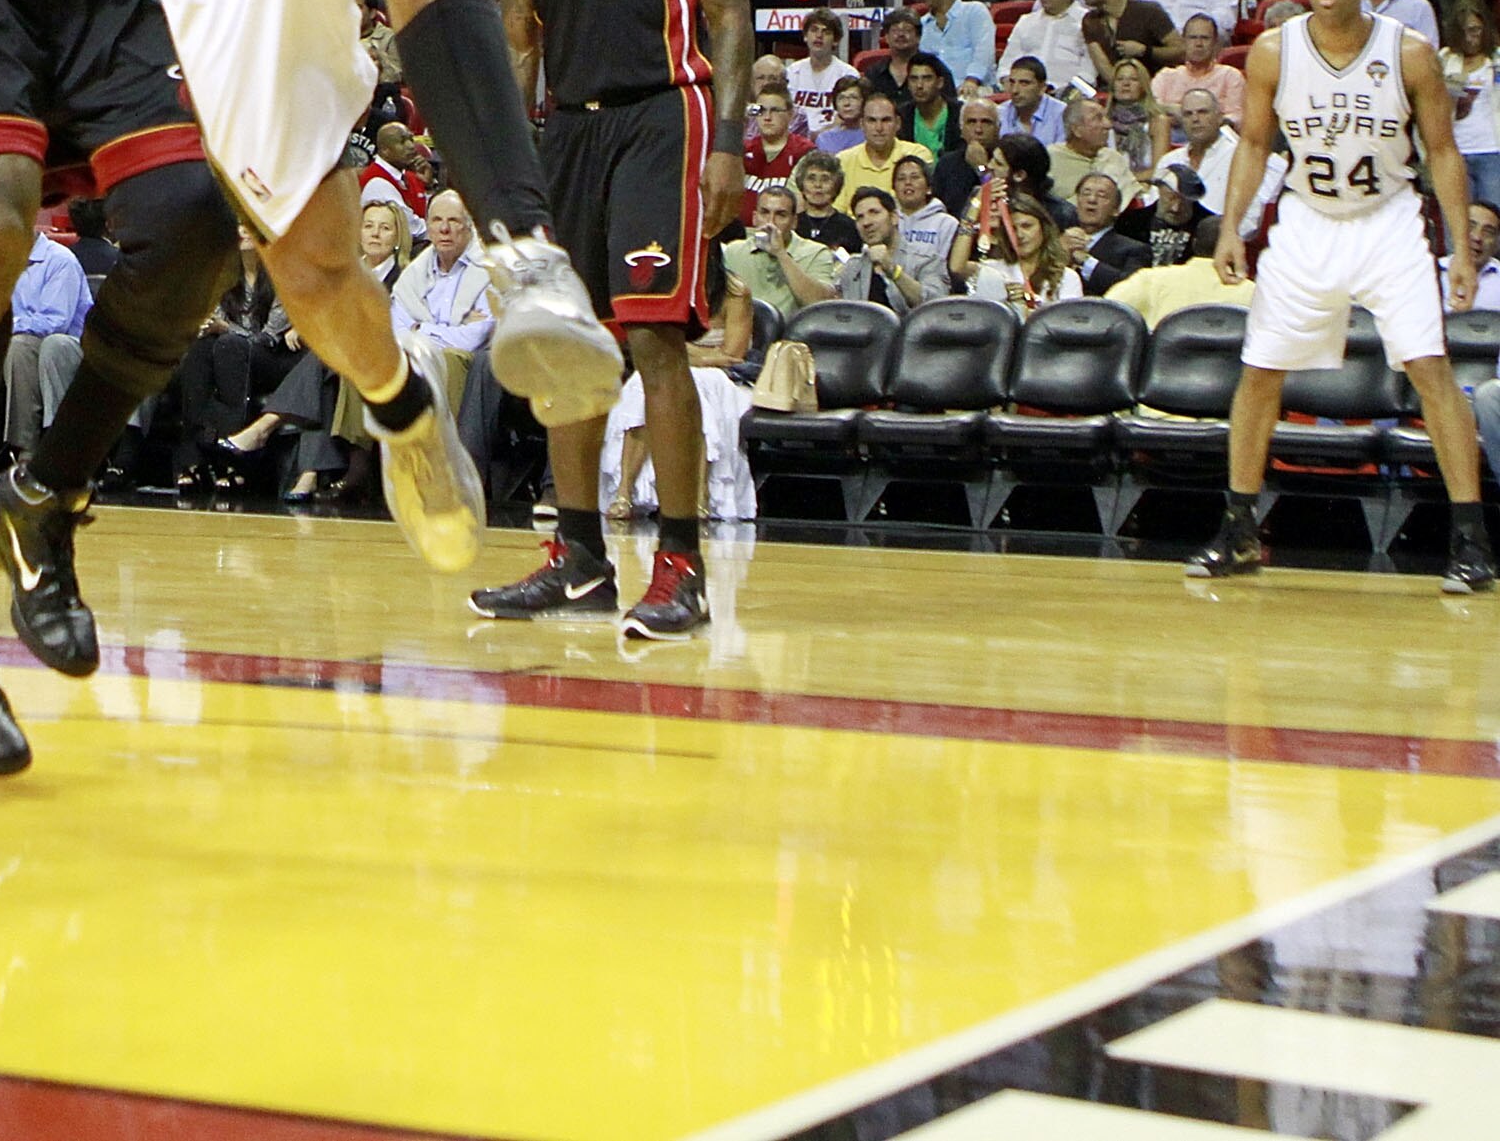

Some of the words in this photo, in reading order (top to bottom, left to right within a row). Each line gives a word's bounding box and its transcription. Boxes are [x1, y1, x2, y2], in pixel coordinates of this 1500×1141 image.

[793, 91, 834, 108] HEAT
[1309, 92, 1371, 110] LOS
[1285, 112, 1399, 140] SPURS
[1304, 155, 1380, 198] 24
